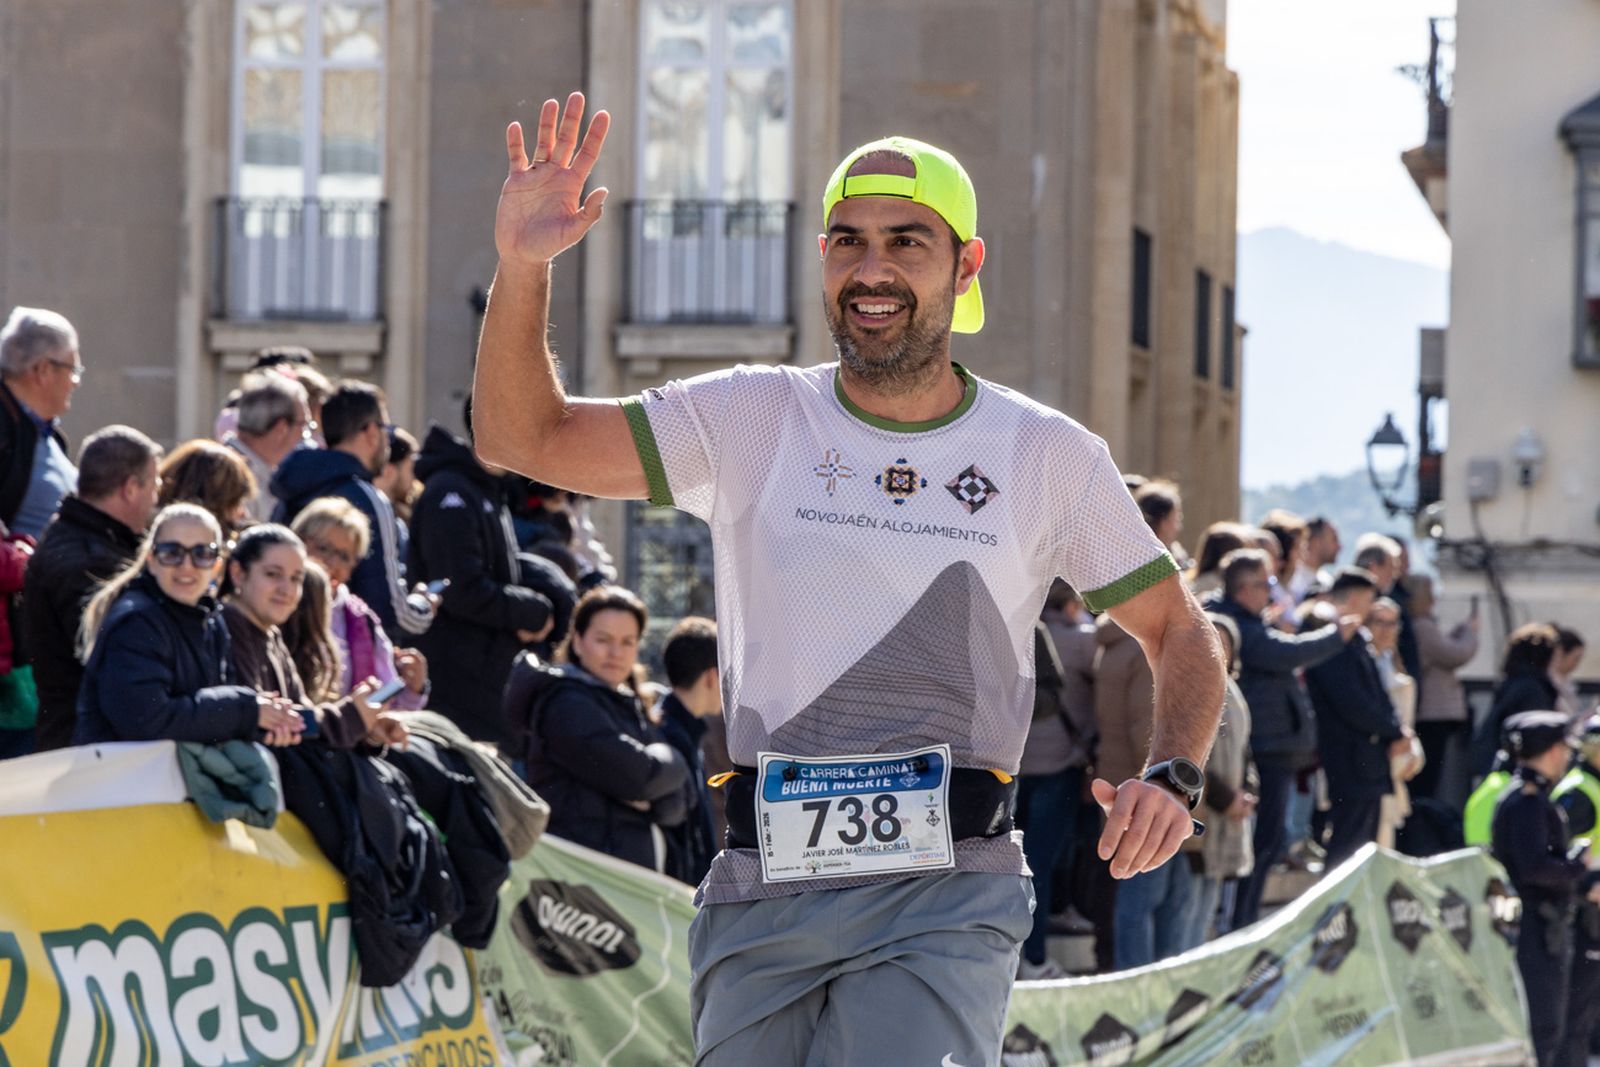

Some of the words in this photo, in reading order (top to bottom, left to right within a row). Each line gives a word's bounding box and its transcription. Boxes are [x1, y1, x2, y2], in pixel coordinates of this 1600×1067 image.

[795, 507, 877, 529] NOVOJAÉN
[880, 519, 998, 547] ALOJAMIENTOS
[800, 766, 856, 779] CARRERA
[858, 762, 916, 777] CAMINAT
[802, 794, 902, 848] 738
[802, 849, 826, 859] JAVIER
[827, 846, 844, 857] JOSÉ
[846, 844, 881, 855] MARTÍNEZ
[883, 842, 910, 851] ROBLES
[46, 910, 475, 1067] masys
